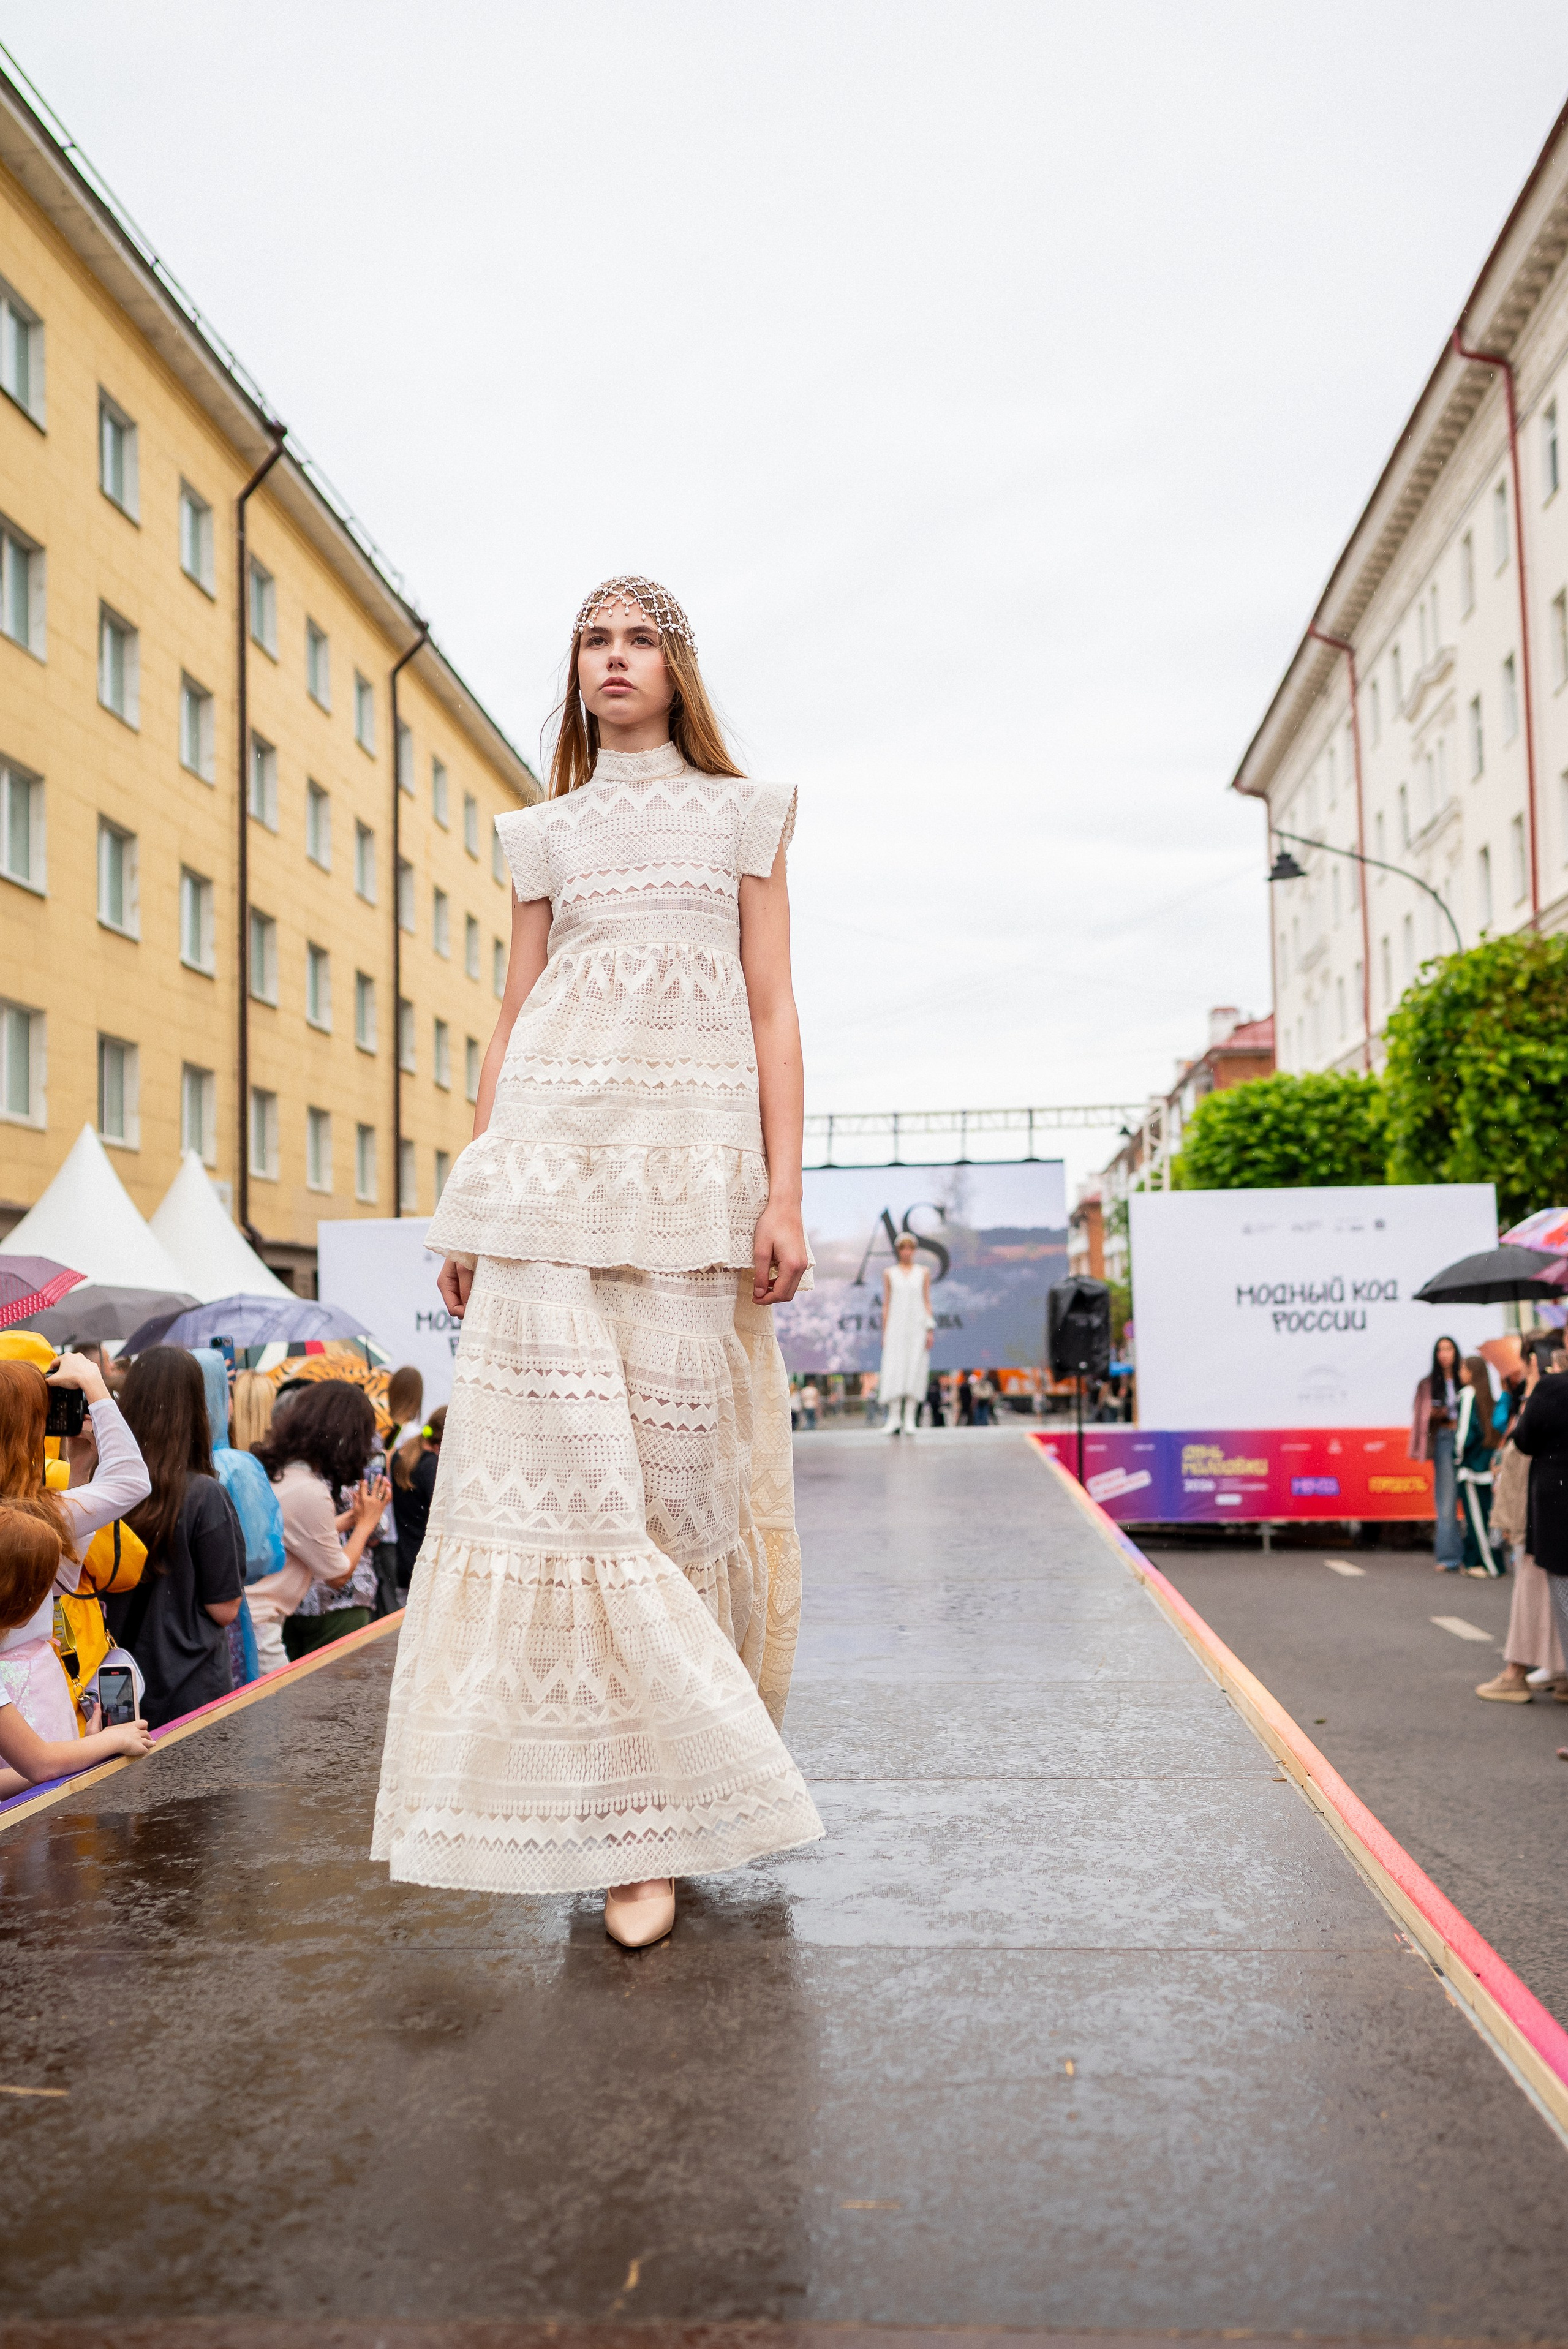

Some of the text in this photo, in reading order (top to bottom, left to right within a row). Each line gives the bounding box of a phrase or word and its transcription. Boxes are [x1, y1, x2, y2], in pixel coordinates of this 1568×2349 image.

[1236, 1276, 1398, 1305] МОДНЫЙ КОД
[1272, 1310, 1366, 1333] РОССИИ
